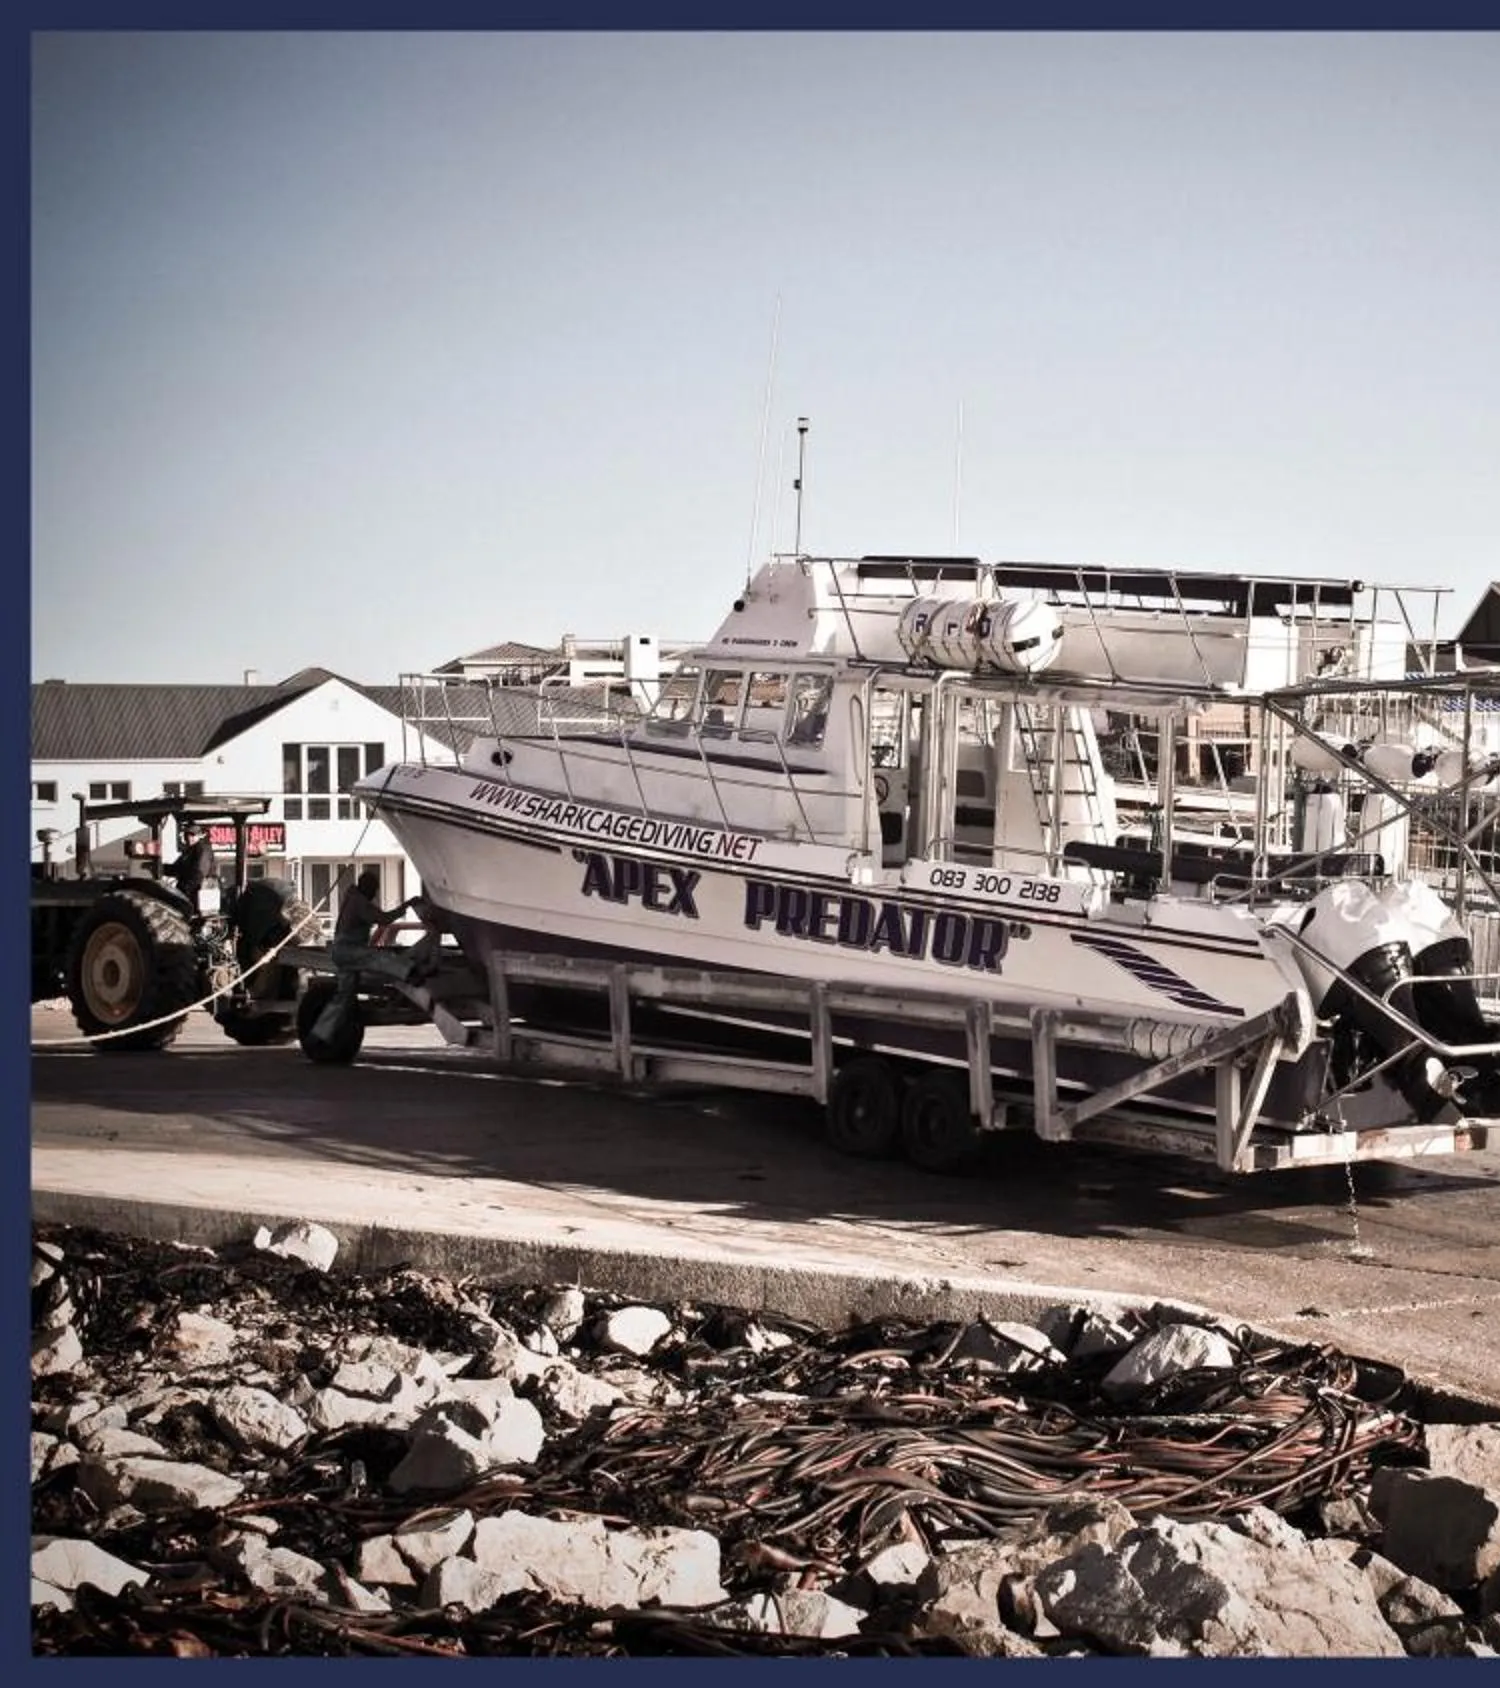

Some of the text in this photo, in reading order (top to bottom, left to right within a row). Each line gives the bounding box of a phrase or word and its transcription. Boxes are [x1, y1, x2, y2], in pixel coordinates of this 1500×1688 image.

[470, 782, 763, 861] WWW.SHARKCAGEDIVING.NET
[930, 868, 1061, 903] 083 300 2138
